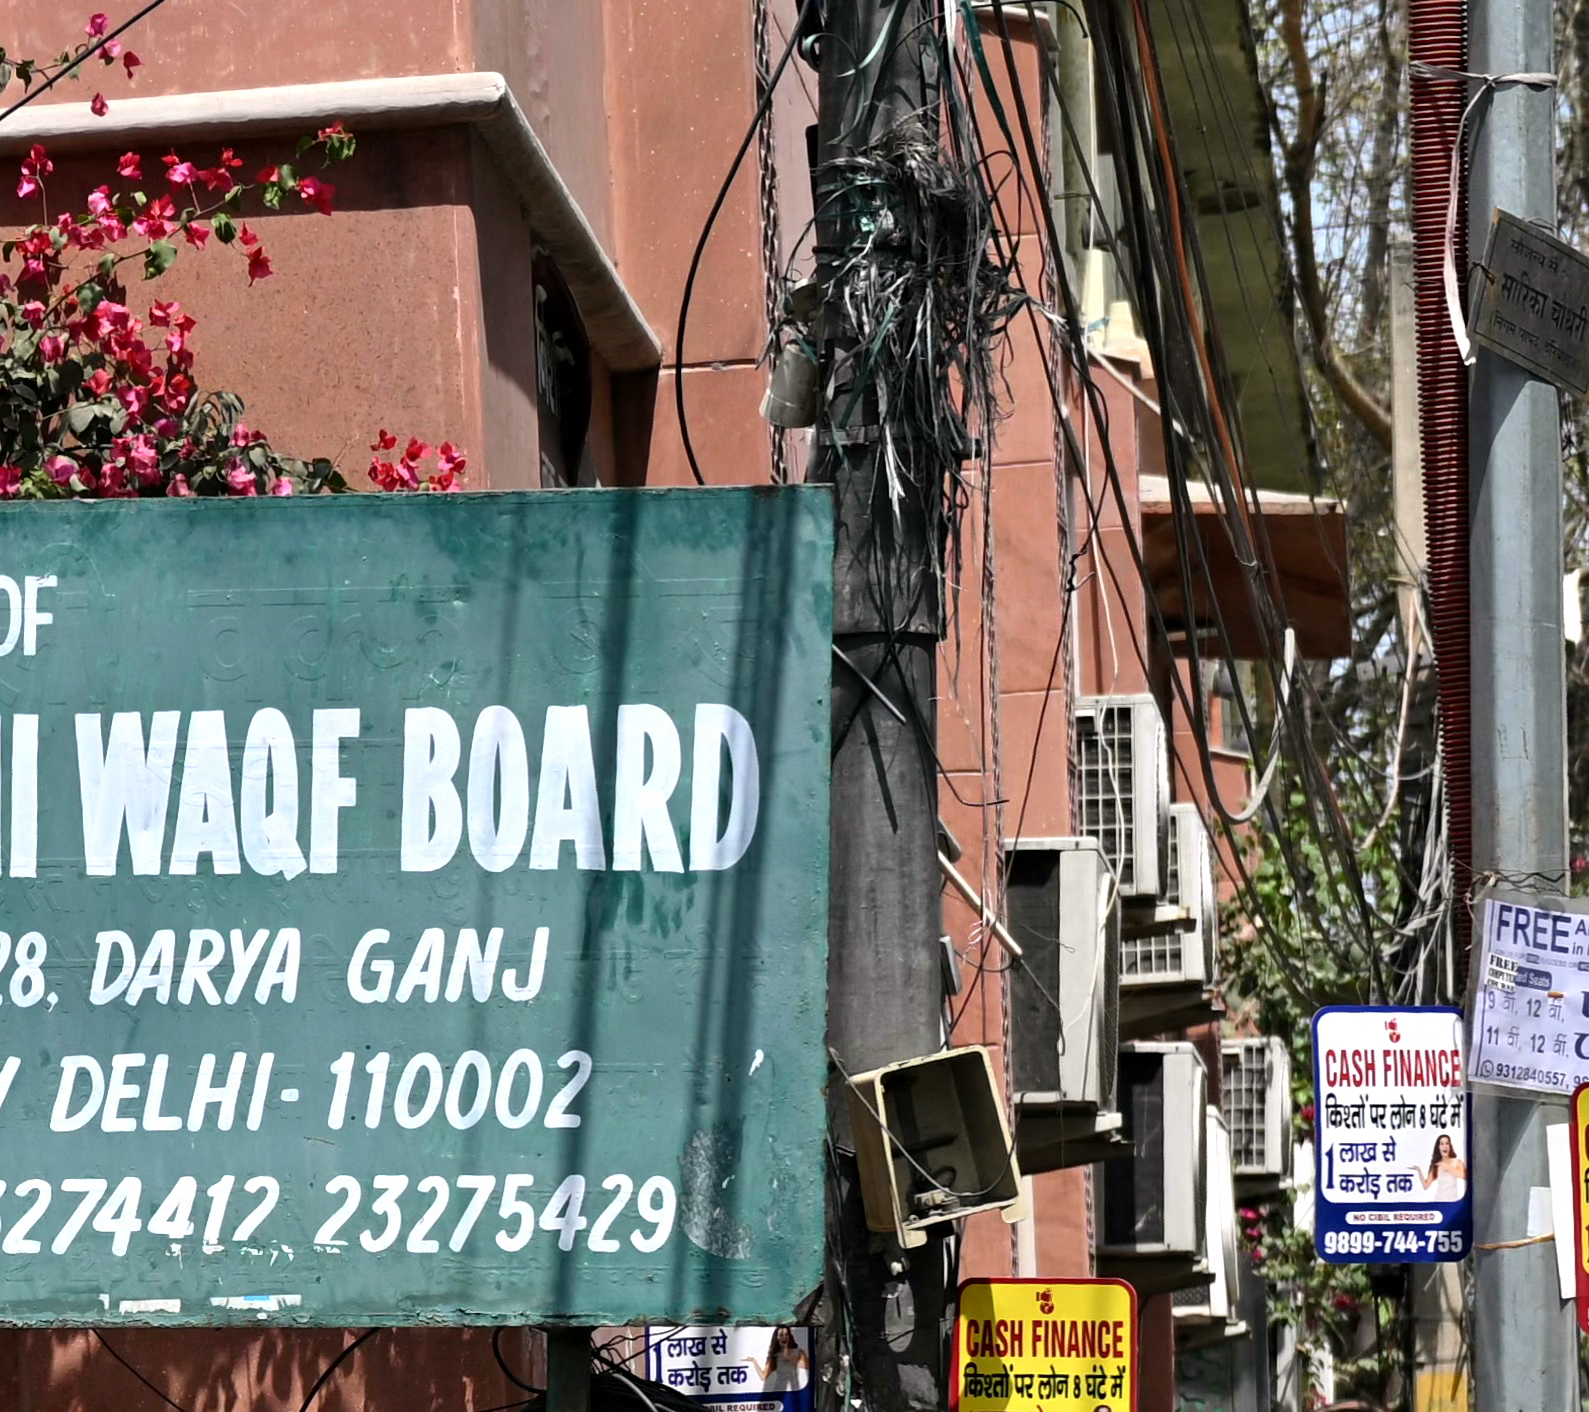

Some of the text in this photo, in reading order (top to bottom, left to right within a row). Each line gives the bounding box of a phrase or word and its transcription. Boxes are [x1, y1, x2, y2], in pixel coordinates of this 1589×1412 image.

[75, 707, 360, 881] WAQF
[400, 703, 759, 873] BOARD
[1496, 905, 1572, 954] FREE
[1490, 955, 1518, 972] FREE
[1573, 943, 1583, 955] in
[89, 927, 301, 1006] DARYA
[347, 926, 550, 1004] GANJ
[1526, 1000, 1542, 1018] 12
[1487, 1026, 1499, 1045] 11
[1531, 1034, 1545, 1053] 12
[1326, 1049, 1461, 1087] CASH FINANCE
[1325, 1093, 1464, 1129] किश्तों पर लोन 8 घंटे में
[1325, 1136, 1396, 1189] 1 लाख से
[1339, 1167, 1414, 1199] करोड़ तक
[313, 1173, 677, 1254] 23275429
[1394, 1213, 1435, 1221] REQUIRED
[1324, 1231, 1463, 1254] 9899-744-755
[667, 1337, 707, 1358] लाख
[711, 1328, 728, 1355] से
[966, 1320, 1123, 1358] CASH FINANCE
[668, 1361, 748, 1393] करोड़ तक
[963, 1362, 1126, 1399] किश्तों पर लोन 8 घंटे में
[727, 1403, 776, 1412] REQUIRED
